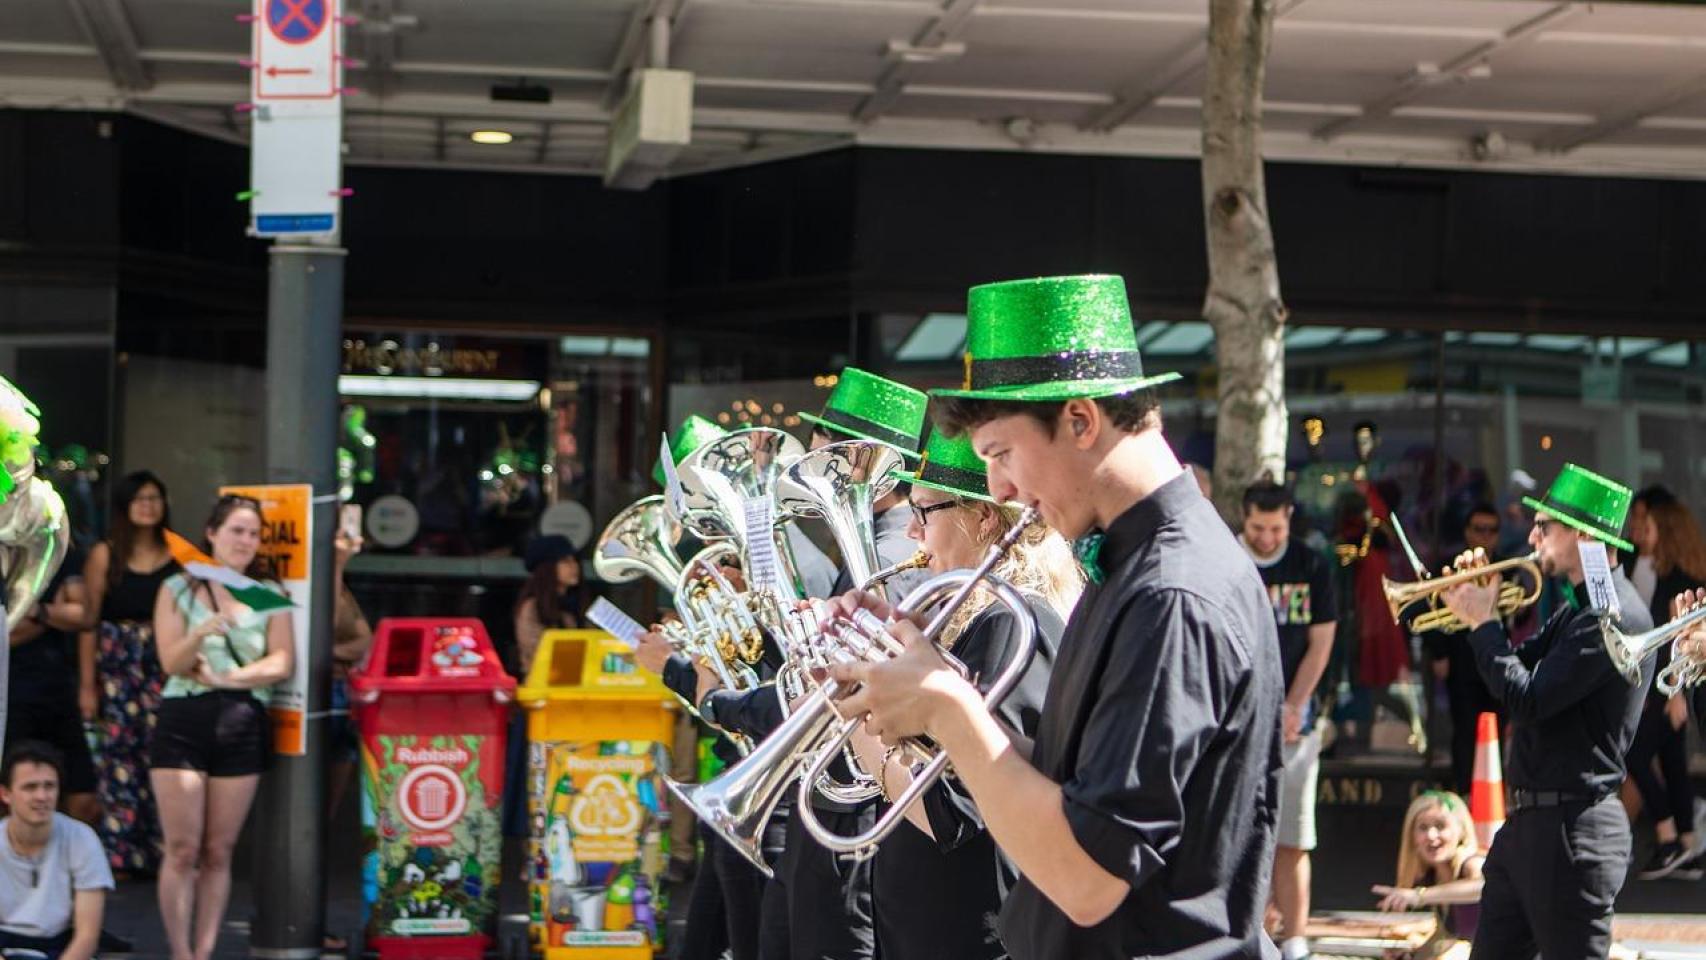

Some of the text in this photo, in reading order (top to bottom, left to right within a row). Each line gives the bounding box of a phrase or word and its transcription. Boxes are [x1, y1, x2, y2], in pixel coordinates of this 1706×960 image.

[260, 520, 300, 545] CIAL
[396, 746, 469, 764] Rubbish
[567, 756, 646, 774] Recycling
[1319, 777, 1383, 804] AND
